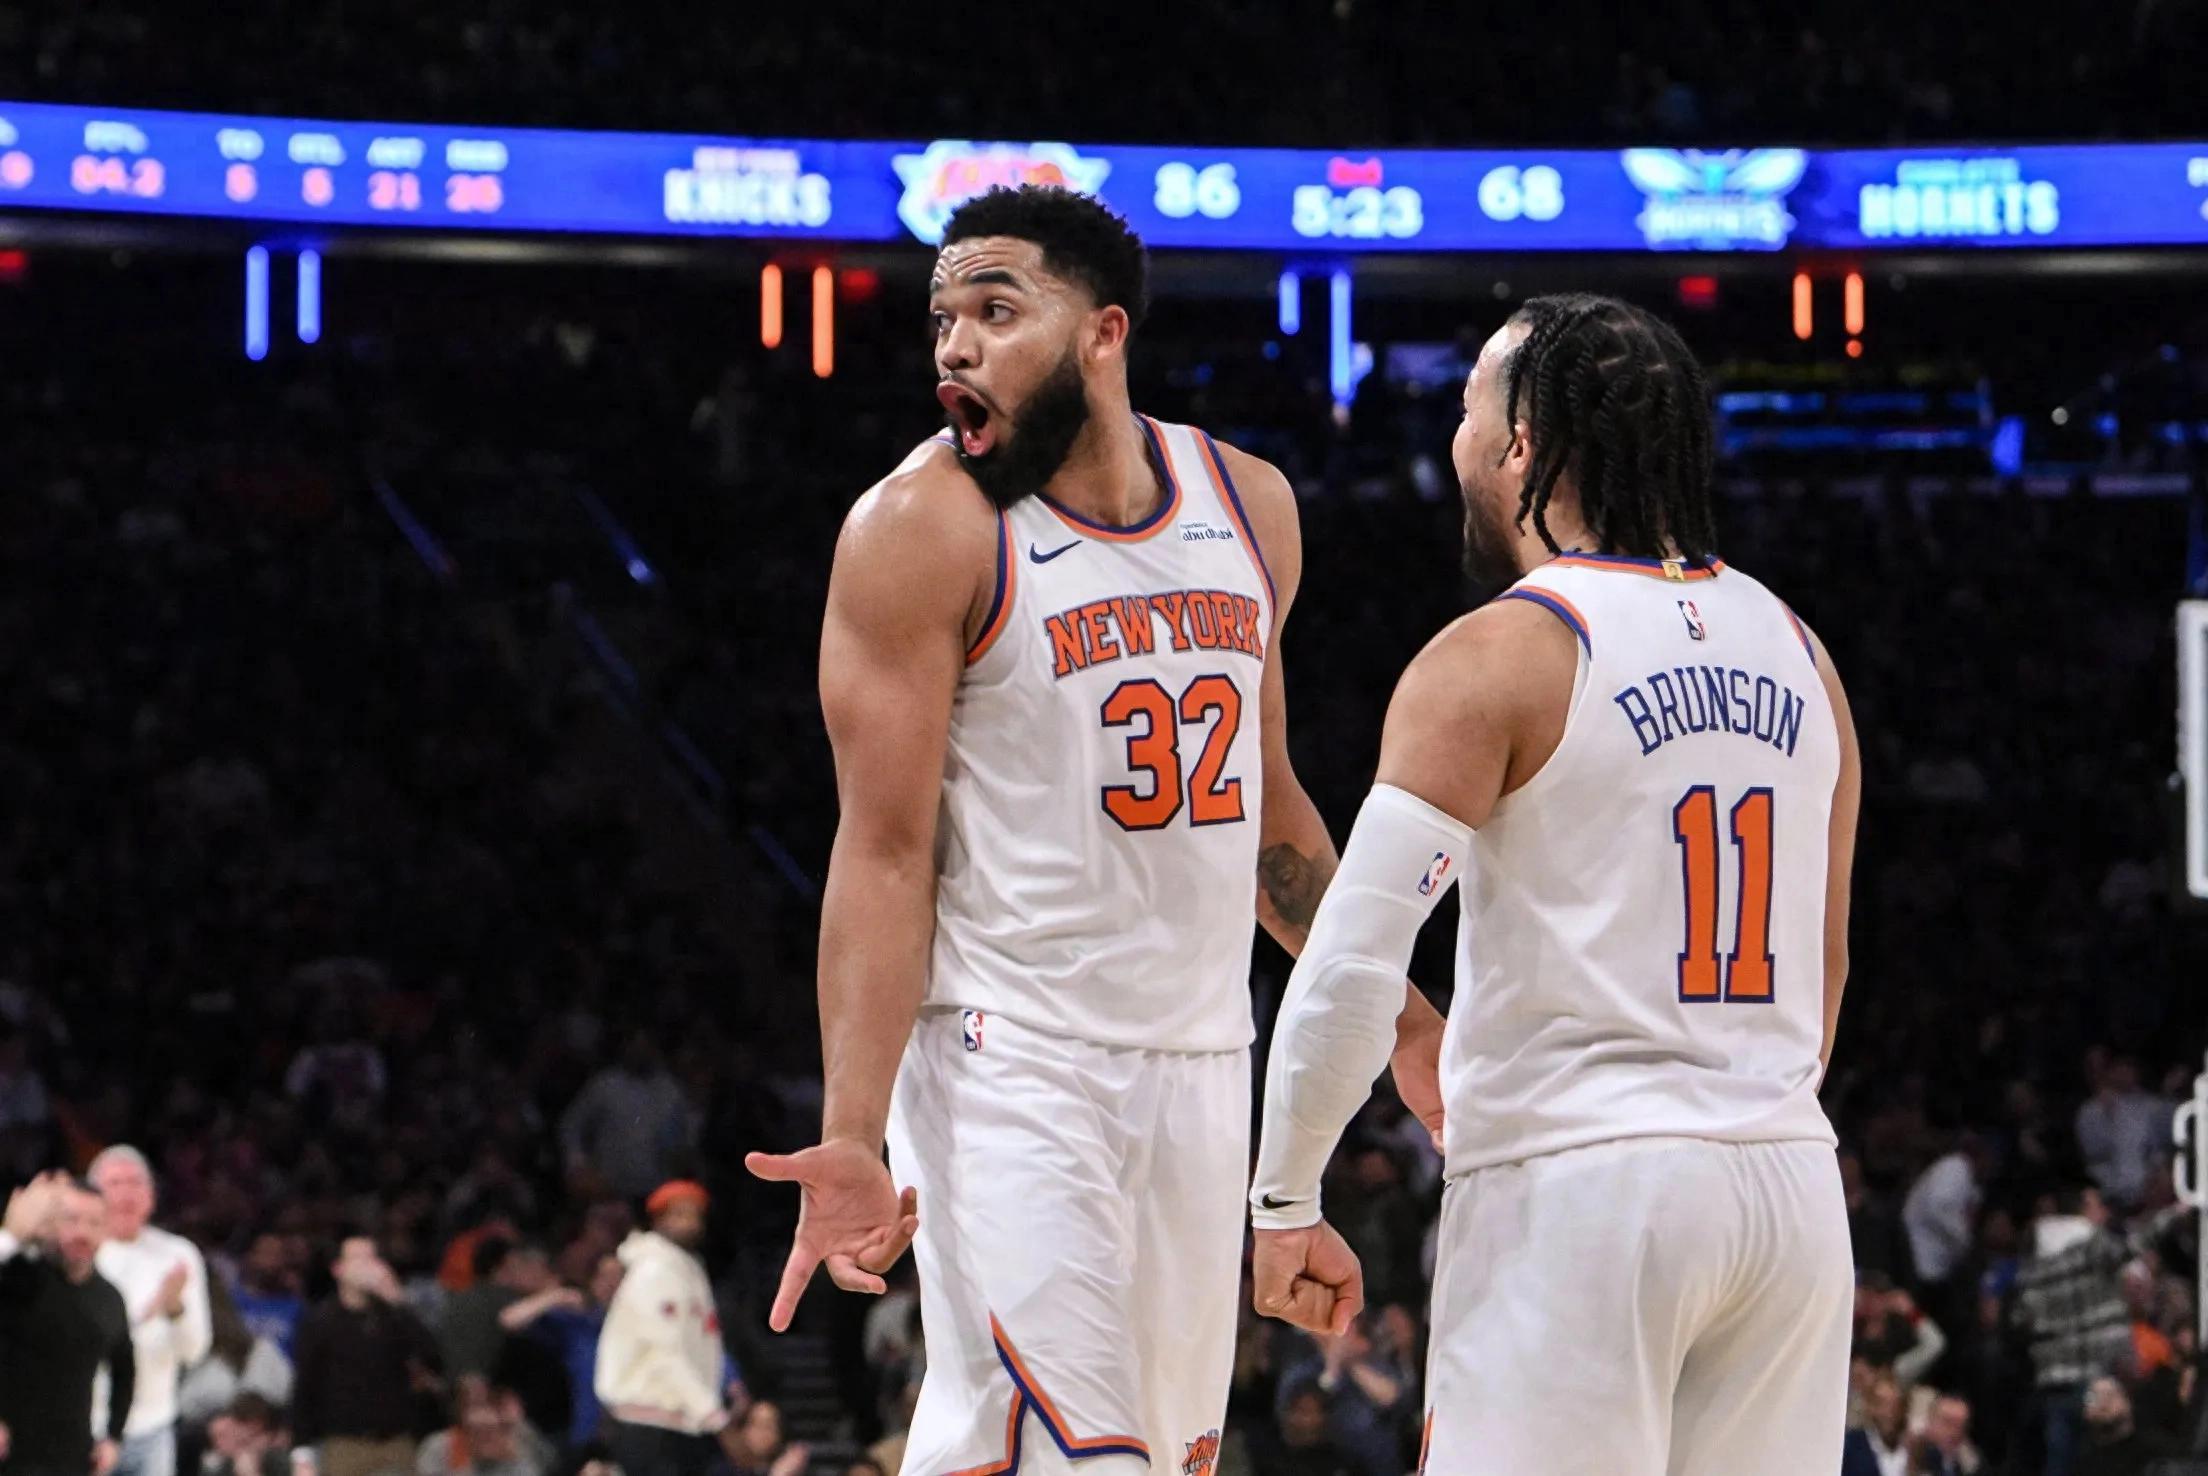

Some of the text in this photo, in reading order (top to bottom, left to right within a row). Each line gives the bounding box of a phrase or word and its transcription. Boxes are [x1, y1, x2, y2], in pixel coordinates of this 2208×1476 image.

[1154, 161, 1241, 219] 86
[1291, 185, 1424, 238] 5:23
[1478, 165, 1564, 221] 68
[1043, 589, 1264, 681] NEW YORK
[1100, 673, 1246, 832] 32
[1613, 666, 1805, 758] BRUNSON
[1672, 785, 1776, 1004] 11
